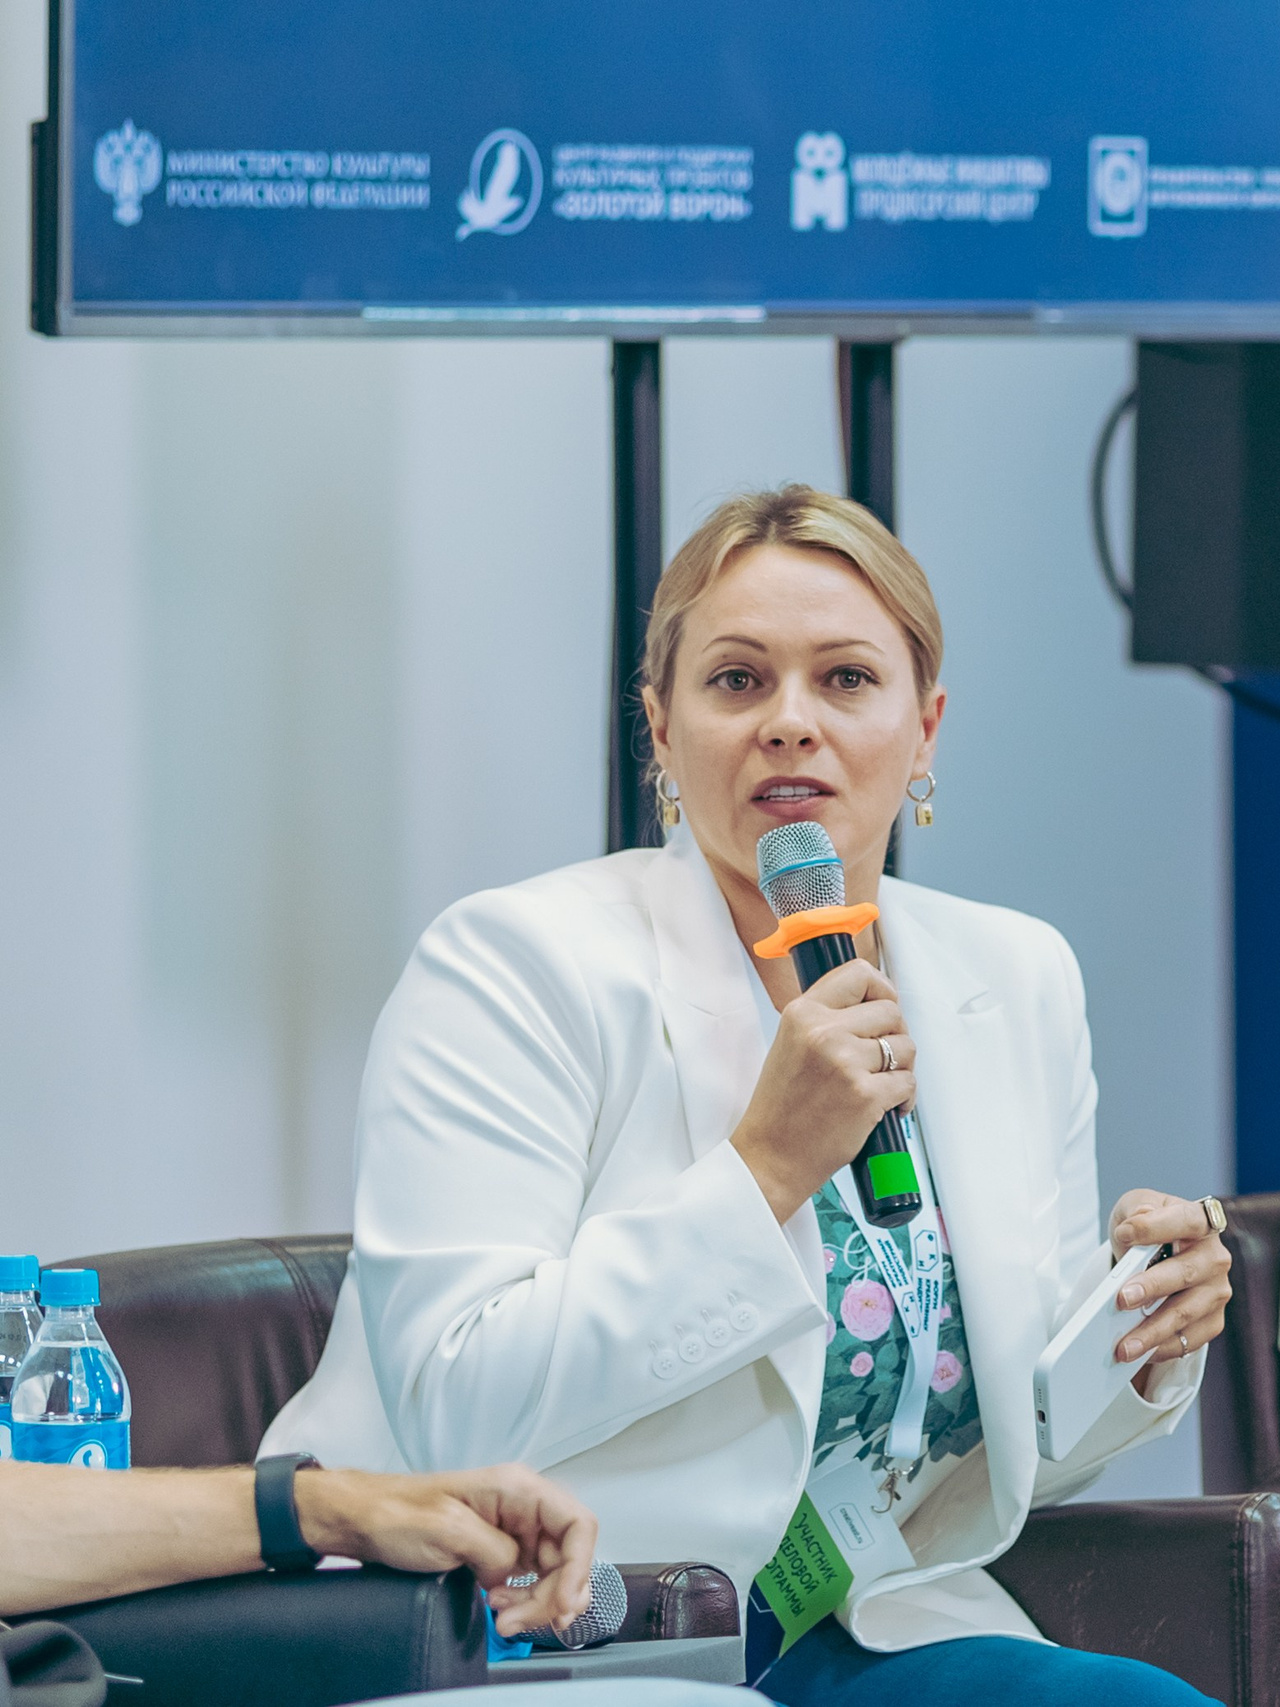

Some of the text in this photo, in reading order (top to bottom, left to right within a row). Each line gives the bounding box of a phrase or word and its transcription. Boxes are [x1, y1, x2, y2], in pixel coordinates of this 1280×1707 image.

[779, 1535, 821, 1595] ДЕЛОВОЙ
[794, 1512, 838, 1584] УЧАСТНИК
[765, 1556, 806, 1618] ОГРАММЫ
